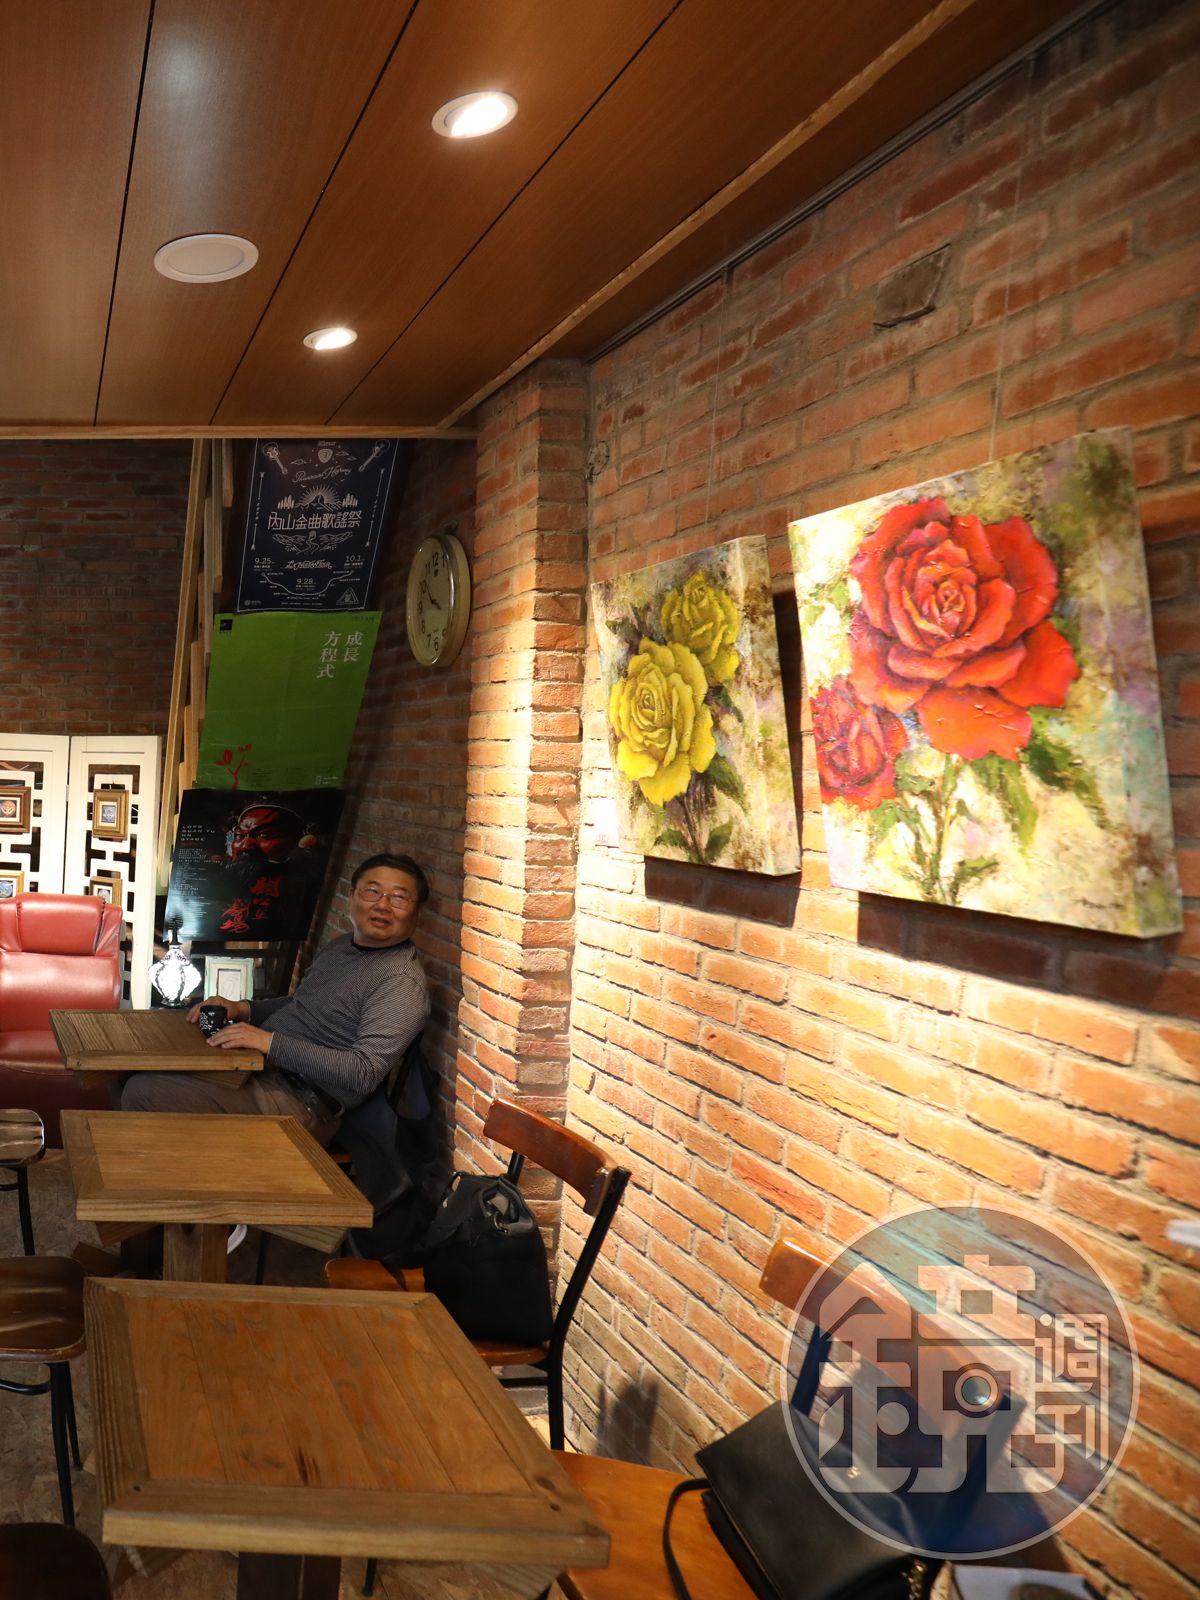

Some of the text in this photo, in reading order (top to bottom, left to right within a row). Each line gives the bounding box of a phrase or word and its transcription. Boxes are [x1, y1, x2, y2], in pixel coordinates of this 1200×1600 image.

[268, 511, 363, 530] 內山金曲歌謠祭
[316, 631, 342, 678] 方程式
[343, 631, 365, 662] 成長
